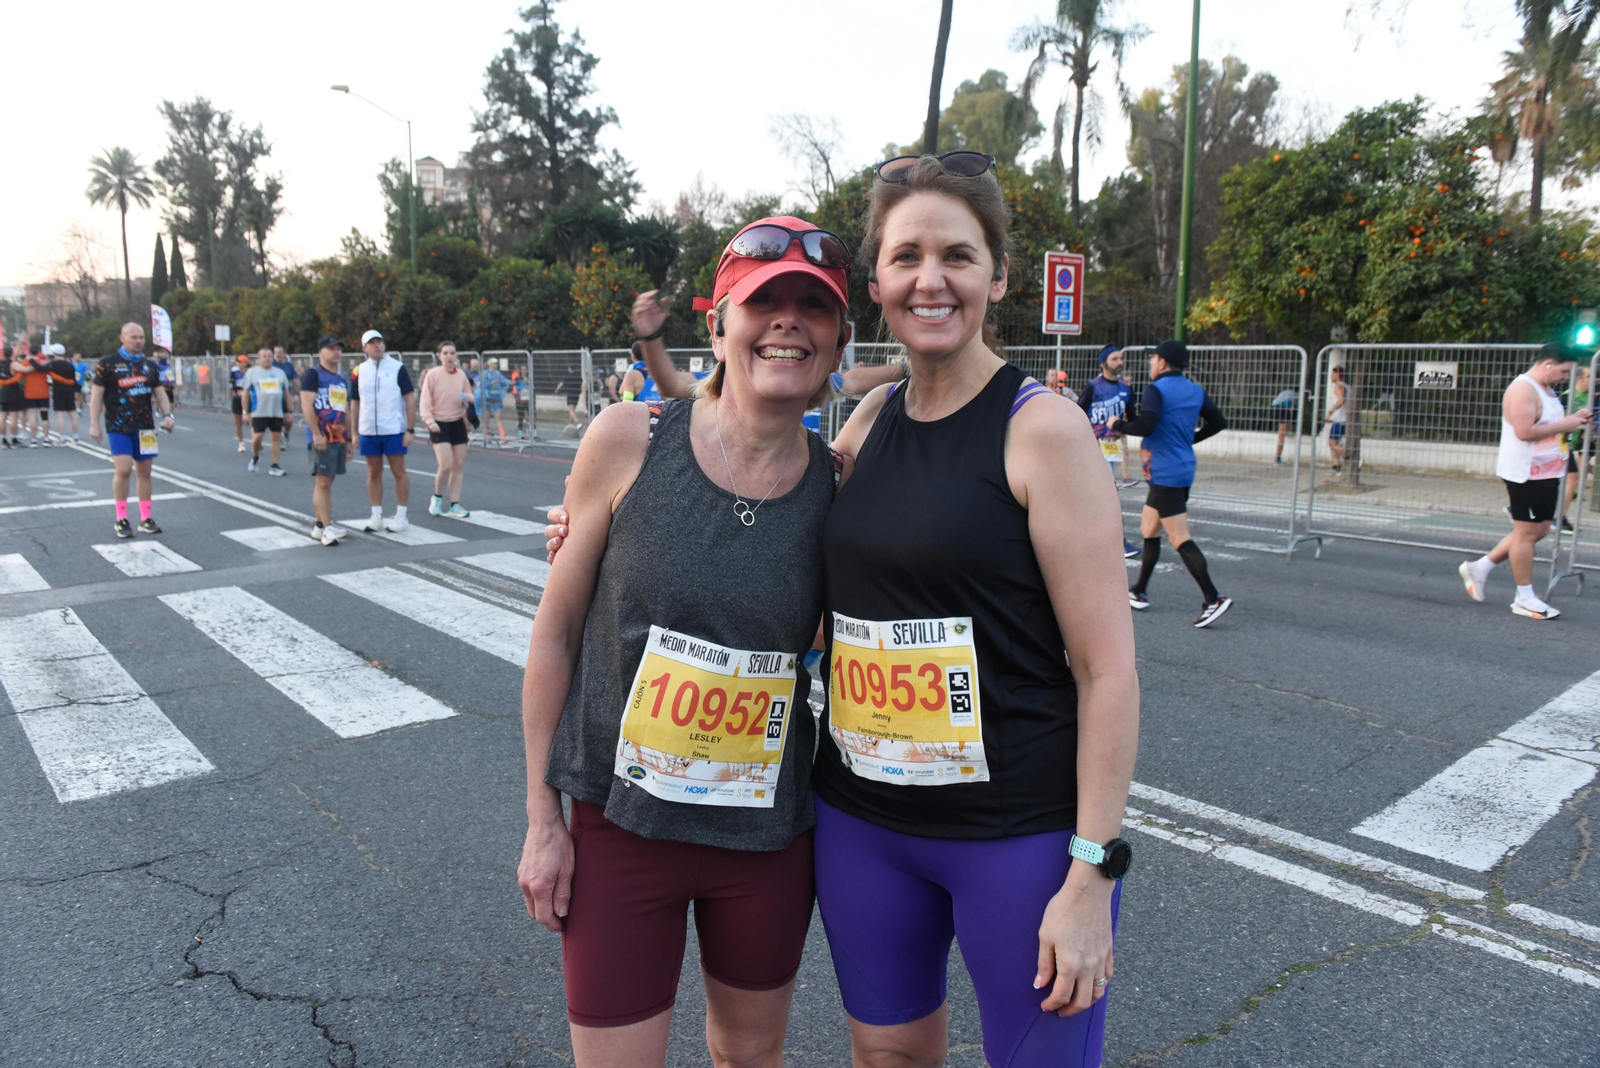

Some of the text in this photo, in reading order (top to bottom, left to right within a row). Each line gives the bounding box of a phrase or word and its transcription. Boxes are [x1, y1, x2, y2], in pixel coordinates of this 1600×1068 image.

[845, 622, 871, 640] MARATÓN
[892, 622, 947, 645] SEVILLA
[659, 633, 730, 667] MEDIO MARATÓN
[747, 652, 783, 674] SEVILLA
[834, 655, 946, 712] 10953
[633, 687, 645, 709] CAJÓN
[650, 672, 770, 736] 10952
[871, 711, 892, 723] Jenny
[689, 732, 722, 744] LESLEY
[857, 726, 914, 740] Farnborough-Brown
[691, 750, 710, 760] Shaw
[882, 765, 905, 776] HOKA
[684, 785, 709, 795] HOKA
